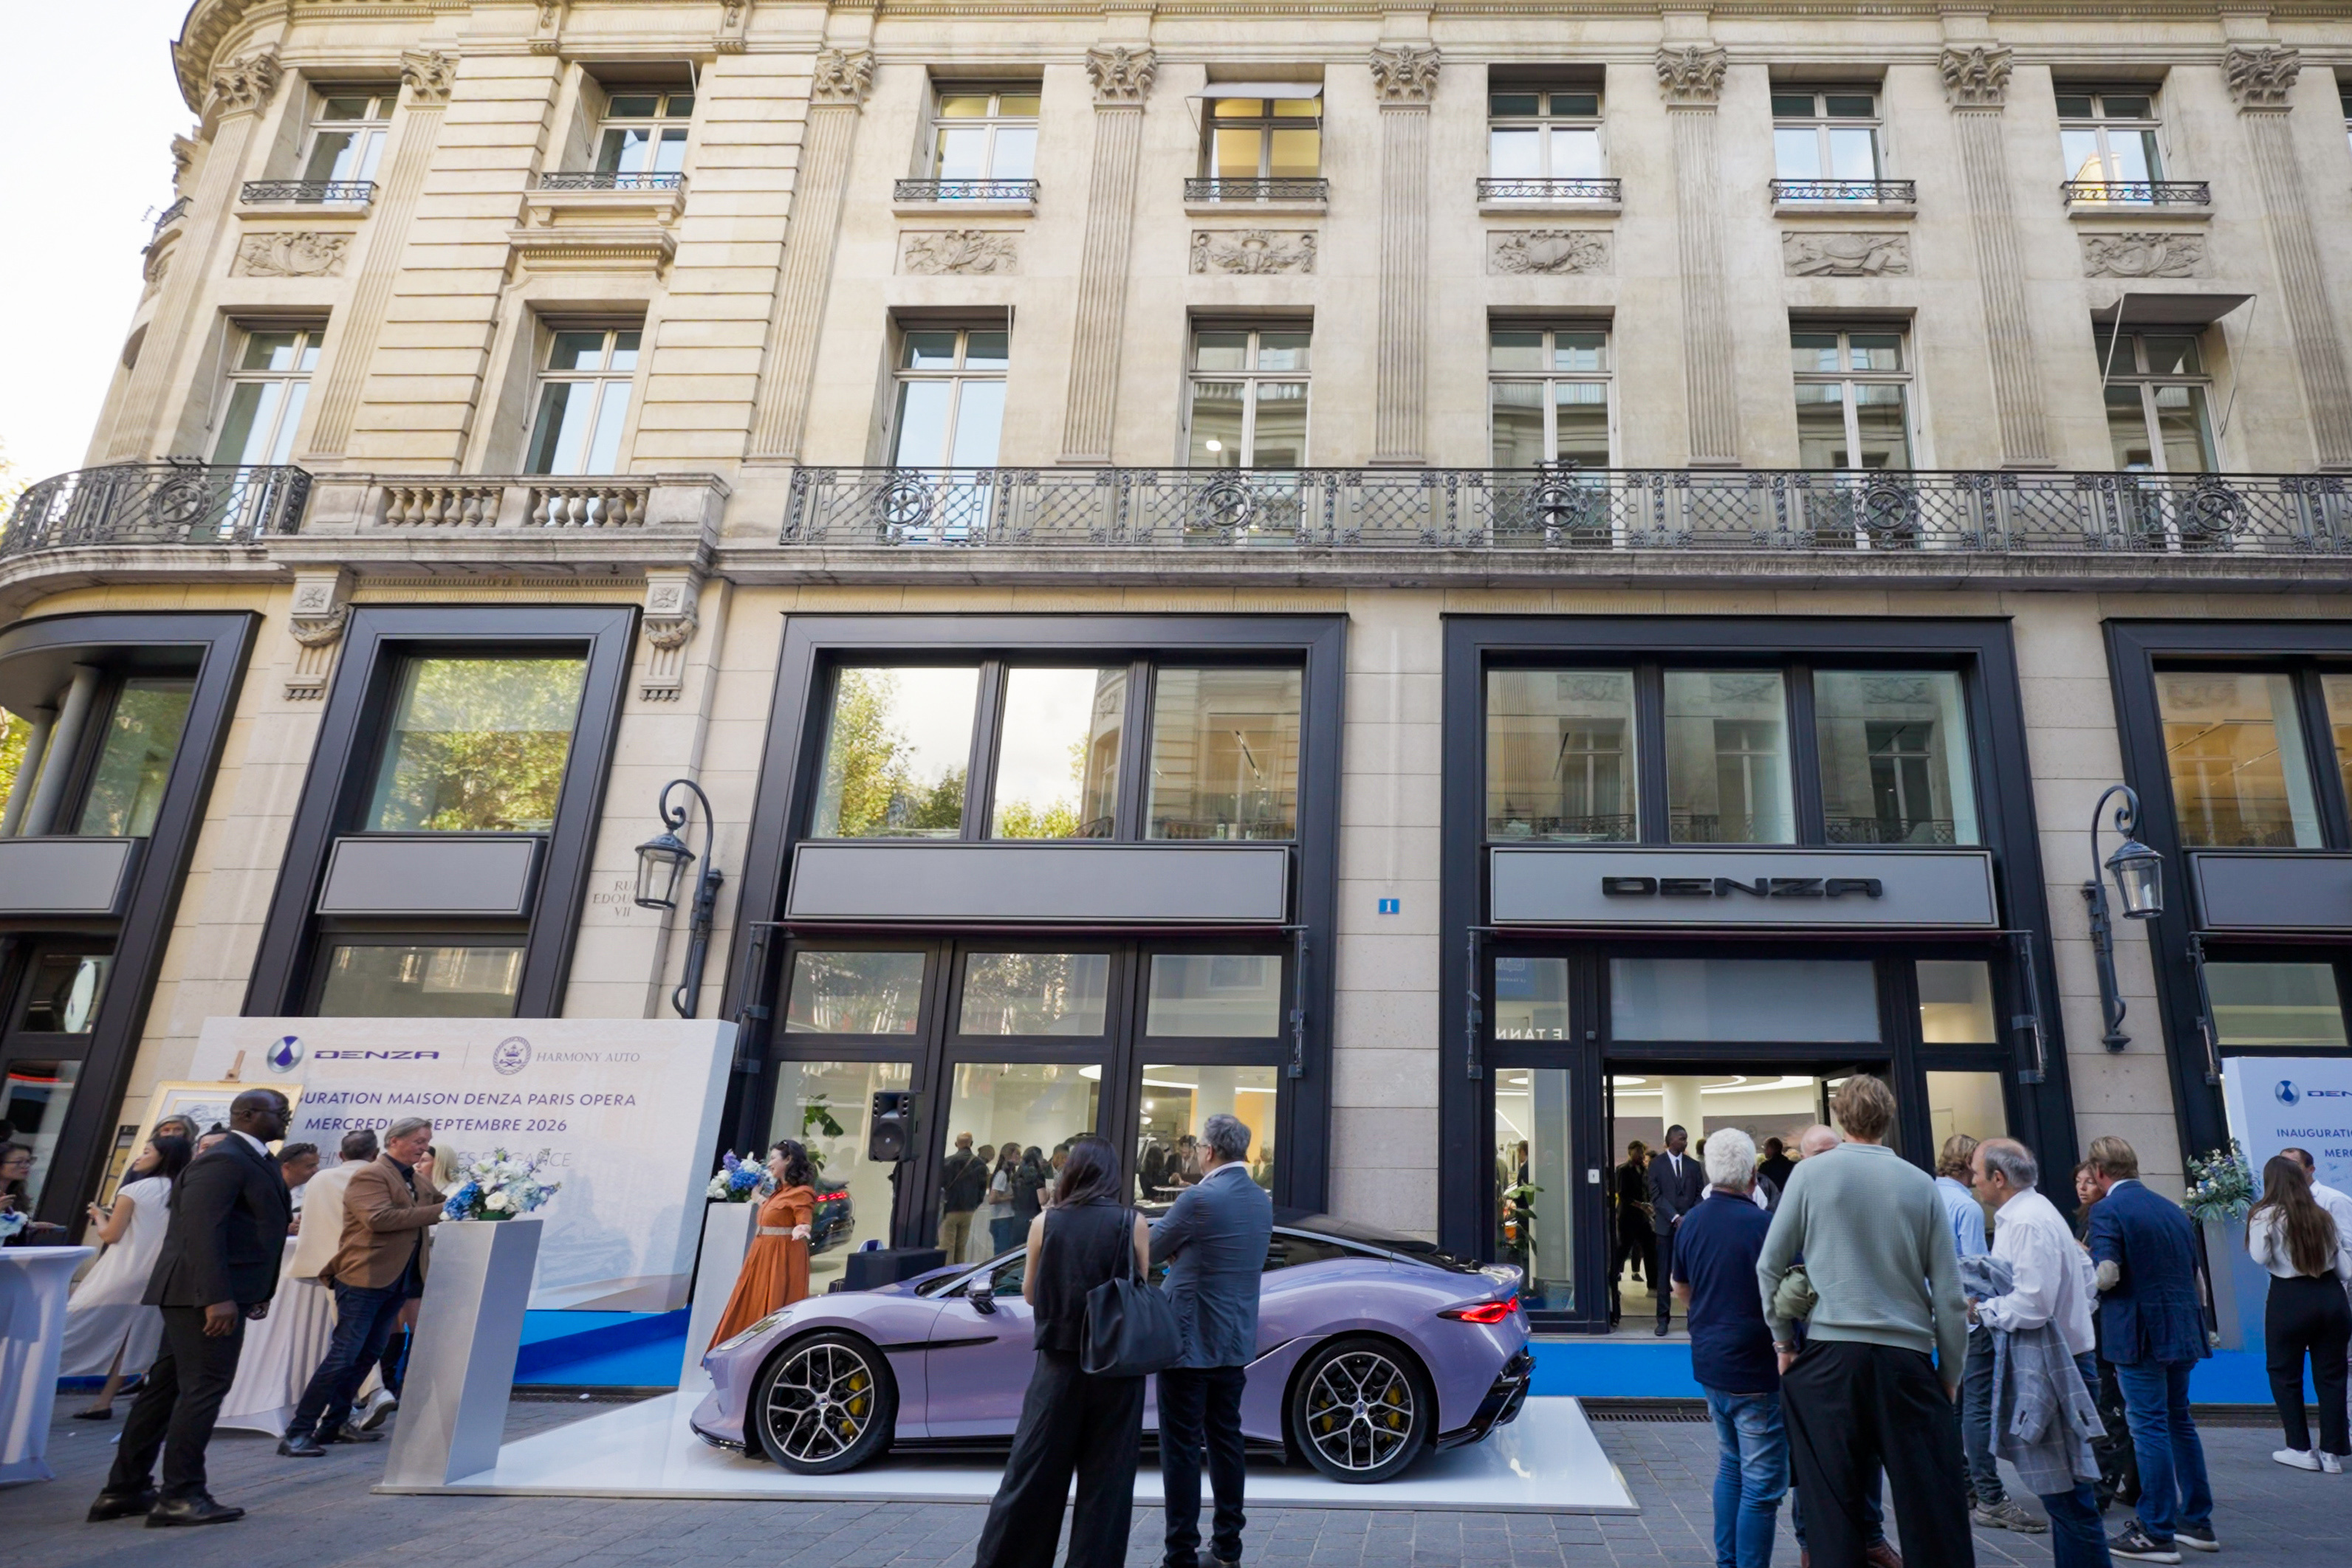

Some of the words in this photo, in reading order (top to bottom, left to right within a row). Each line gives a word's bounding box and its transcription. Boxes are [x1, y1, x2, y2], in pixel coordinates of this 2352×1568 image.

[1602, 876, 1882, 896] DENZA
[1385, 900, 1393, 912] 1
[614, 907, 631, 917] VII
[314, 1051, 440, 1059] DENZA
[536, 1052, 603, 1062] HARMONY
[604, 1053, 641, 1062] AUTO
[300, 1093, 383, 1104] URATION
[387, 1093, 459, 1105] MAISON
[464, 1093, 522, 1105] DENZA
[527, 1093, 575, 1106] PARIS
[580, 1094, 637, 1107] OPERA
[430, 1118, 522, 1131] EPTEMBRE
[526, 1119, 567, 1132] 2026
[2277, 1129, 2352, 1138] INAUGURATI
